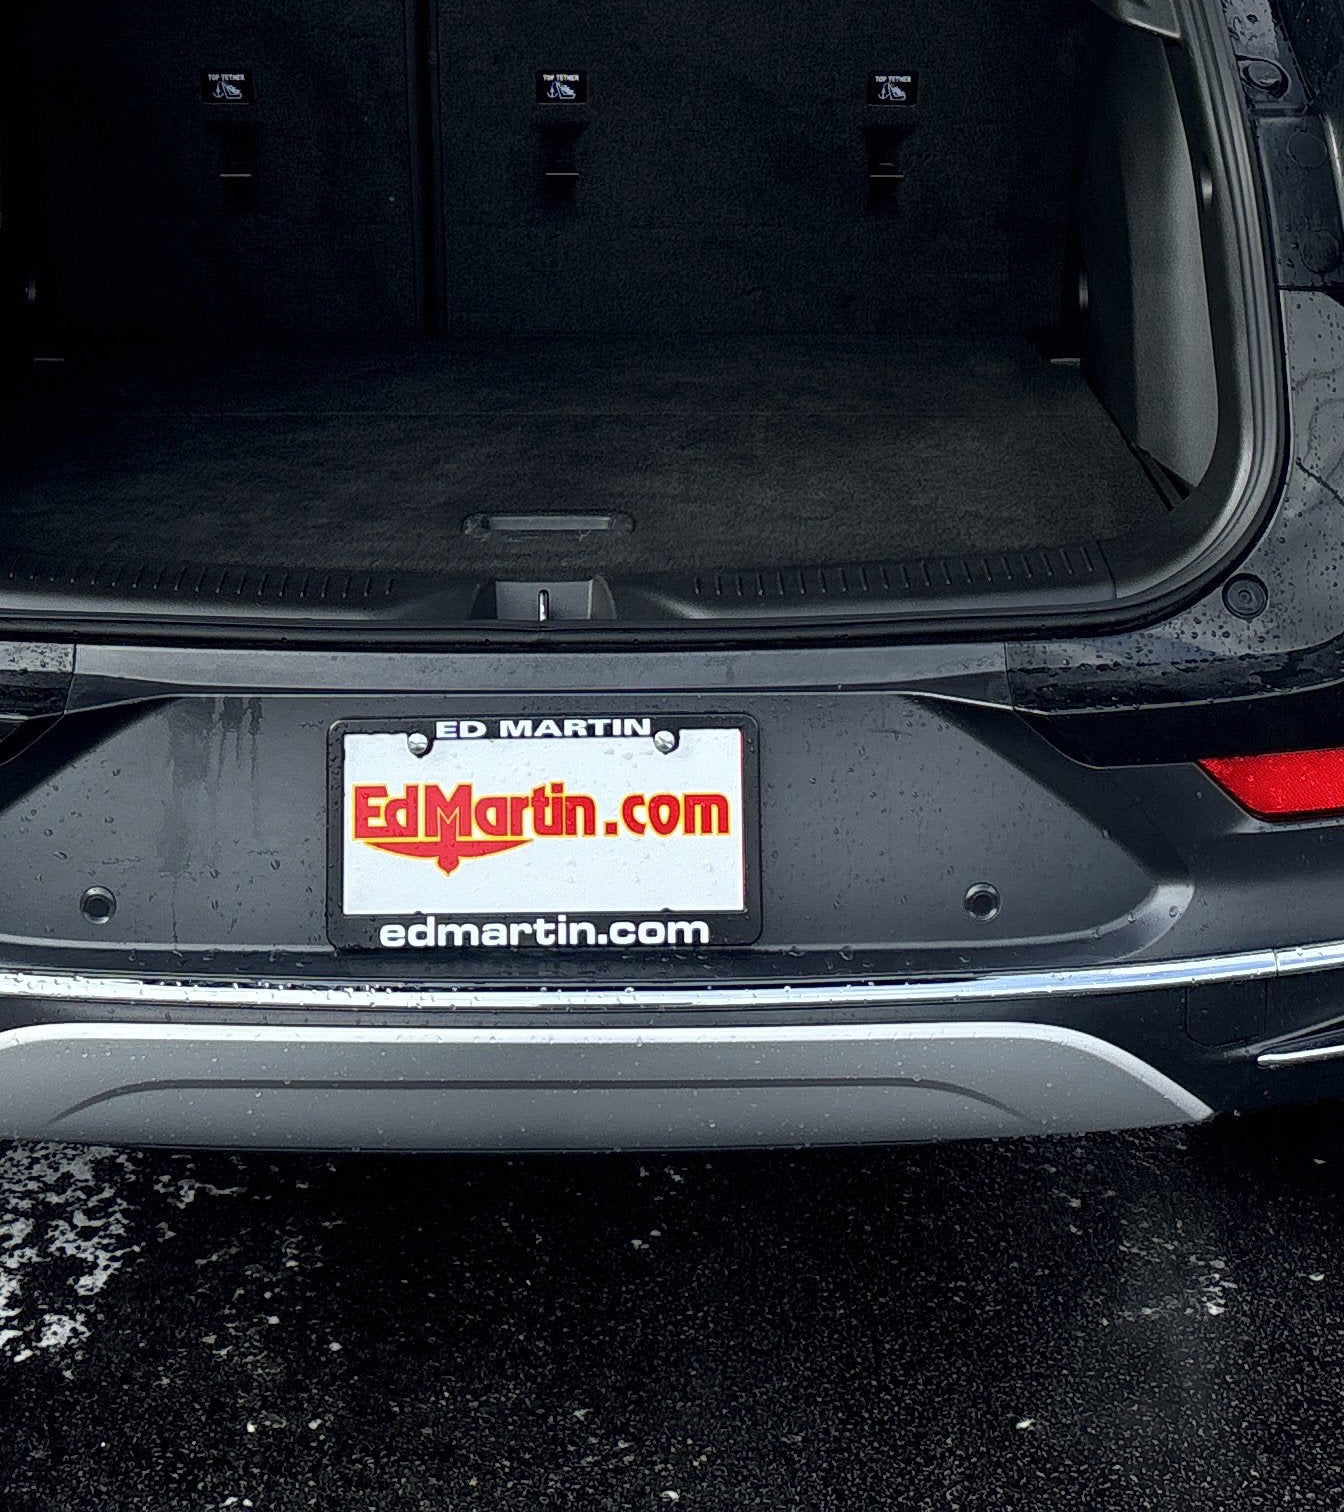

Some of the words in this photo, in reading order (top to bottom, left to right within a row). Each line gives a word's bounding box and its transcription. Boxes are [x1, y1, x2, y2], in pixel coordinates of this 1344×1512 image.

[435, 720, 487, 738] ED
[499, 718, 652, 738] MARTIN
[351, 780, 732, 841] EdMartin.com
[378, 914, 710, 947] edmartin.com
